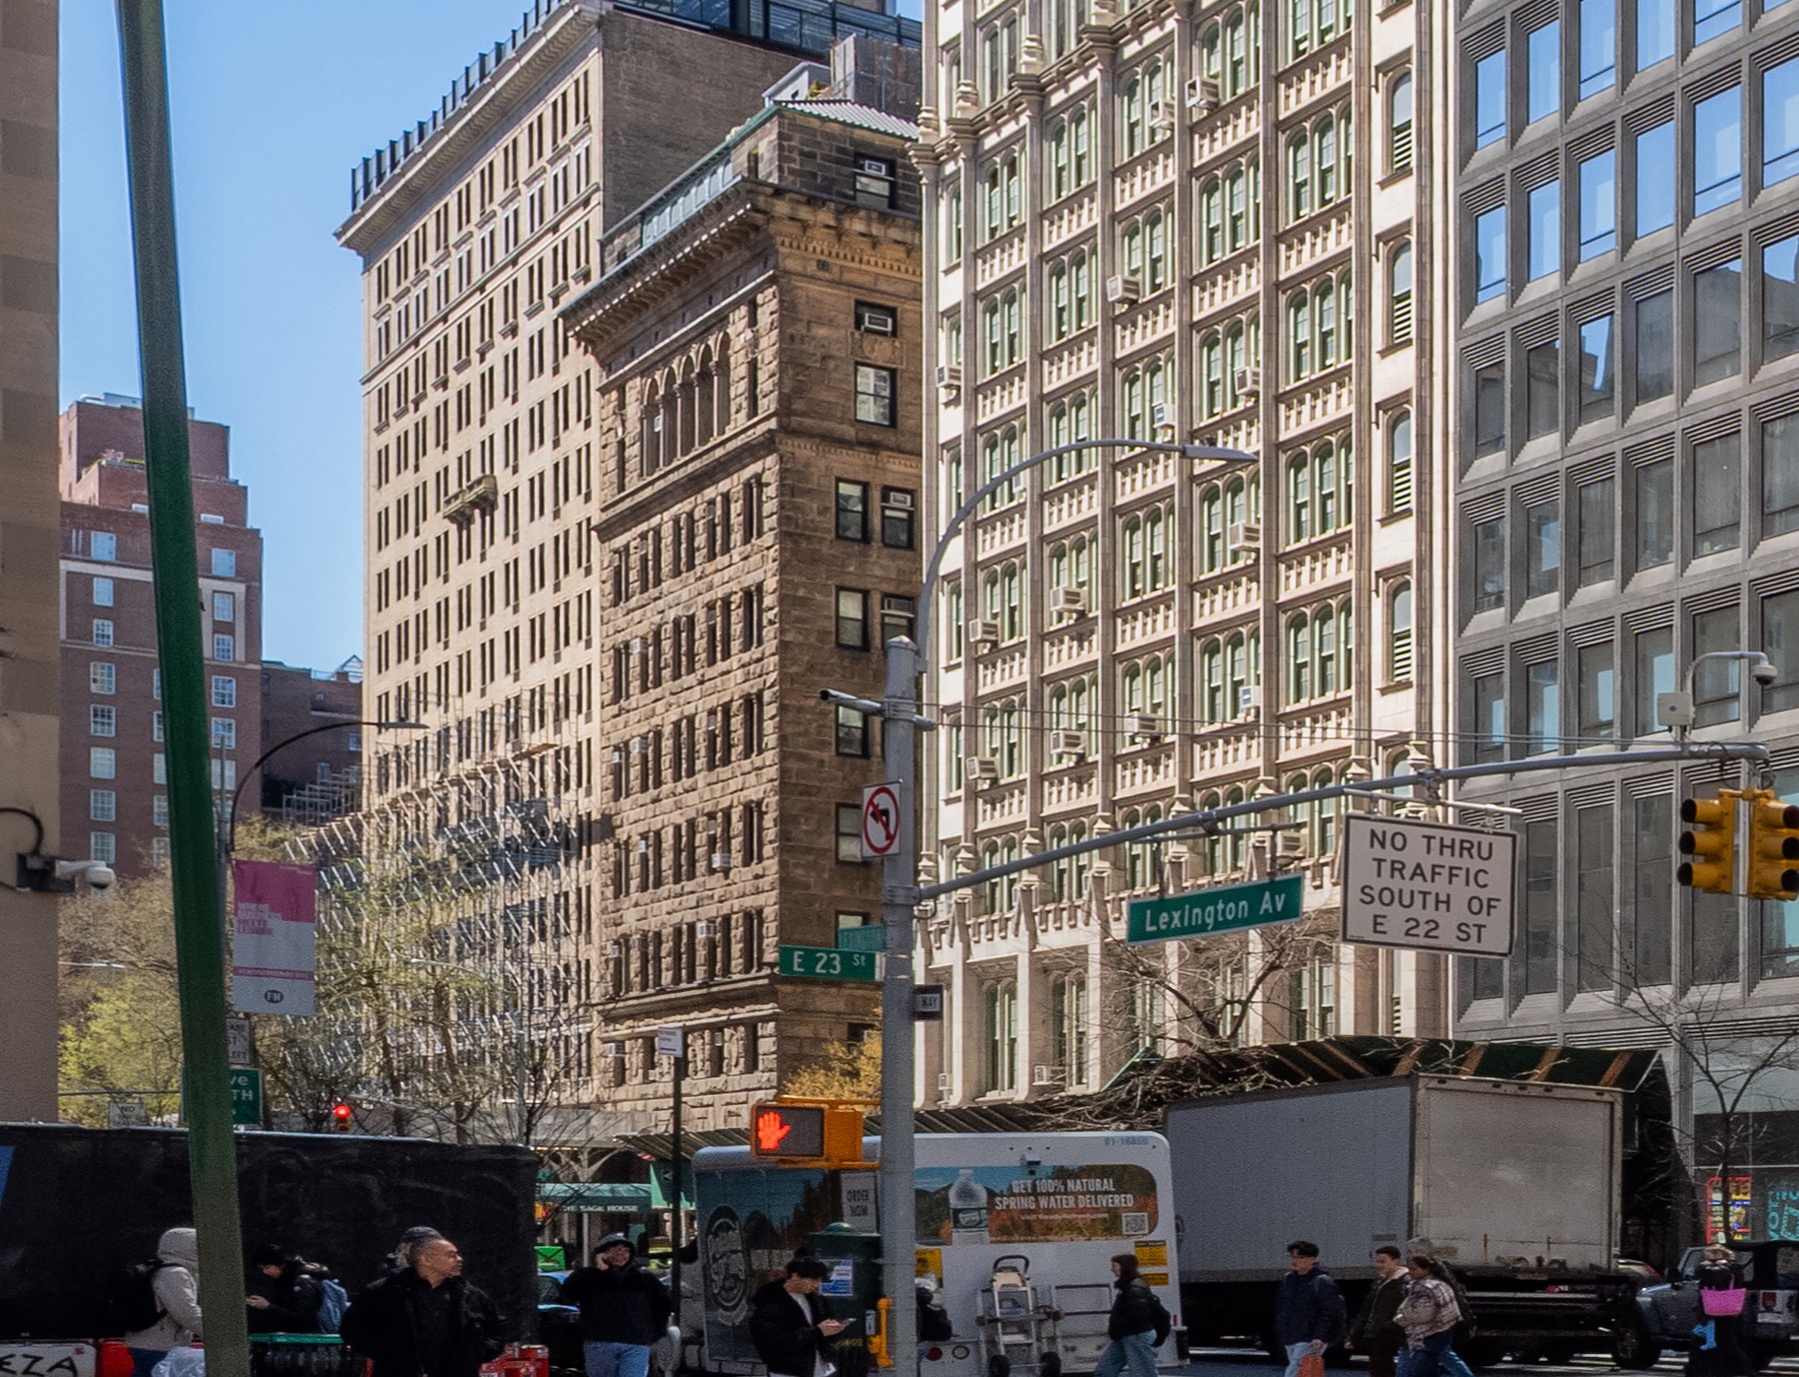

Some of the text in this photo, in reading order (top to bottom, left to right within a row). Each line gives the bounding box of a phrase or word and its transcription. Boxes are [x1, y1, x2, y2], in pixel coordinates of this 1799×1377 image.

[1370, 829, 1493, 861] NO THRU
[1372, 857, 1489, 889] TRAFFIC
[1145, 890, 1286, 932] Lexington Av
[1359, 885, 1501, 917] SOUTH OF
[1373, 914, 1487, 943] E 22 ST
[793, 951, 867, 975] E 23 St
[846, 1189, 870, 1202] ORDER
[1012, 1178, 1116, 1194] GET 100% NATURAL
[607, 1205, 639, 1213] HOUSE
[995, 1193, 1134, 1211] SPRING WATER DELIVERED
